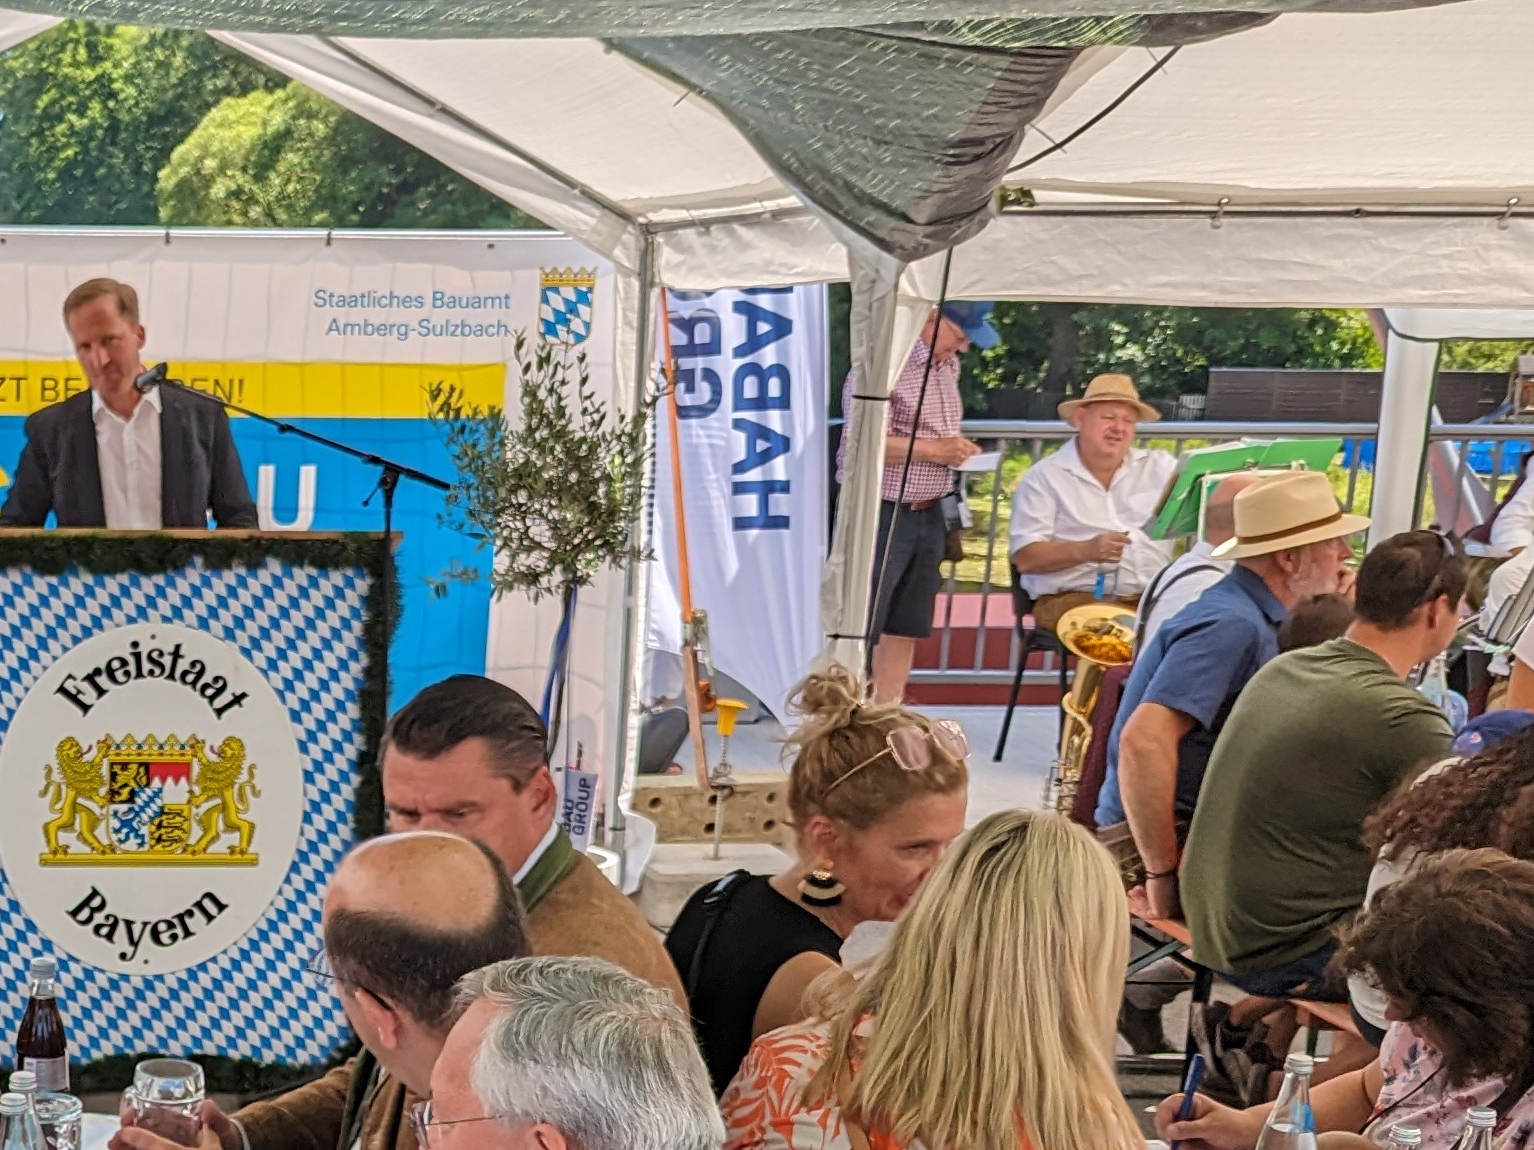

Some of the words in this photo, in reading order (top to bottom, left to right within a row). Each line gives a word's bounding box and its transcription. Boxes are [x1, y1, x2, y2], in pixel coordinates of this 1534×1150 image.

[313, 289, 424, 310] Staatliches
[432, 291, 511, 310] Bauamt
[325, 317, 508, 341] Amberg-Sulzbach
[52, 639, 251, 720] Freistaat
[571, 777, 591, 836] GROUP
[66, 885, 230, 964] Bayern
